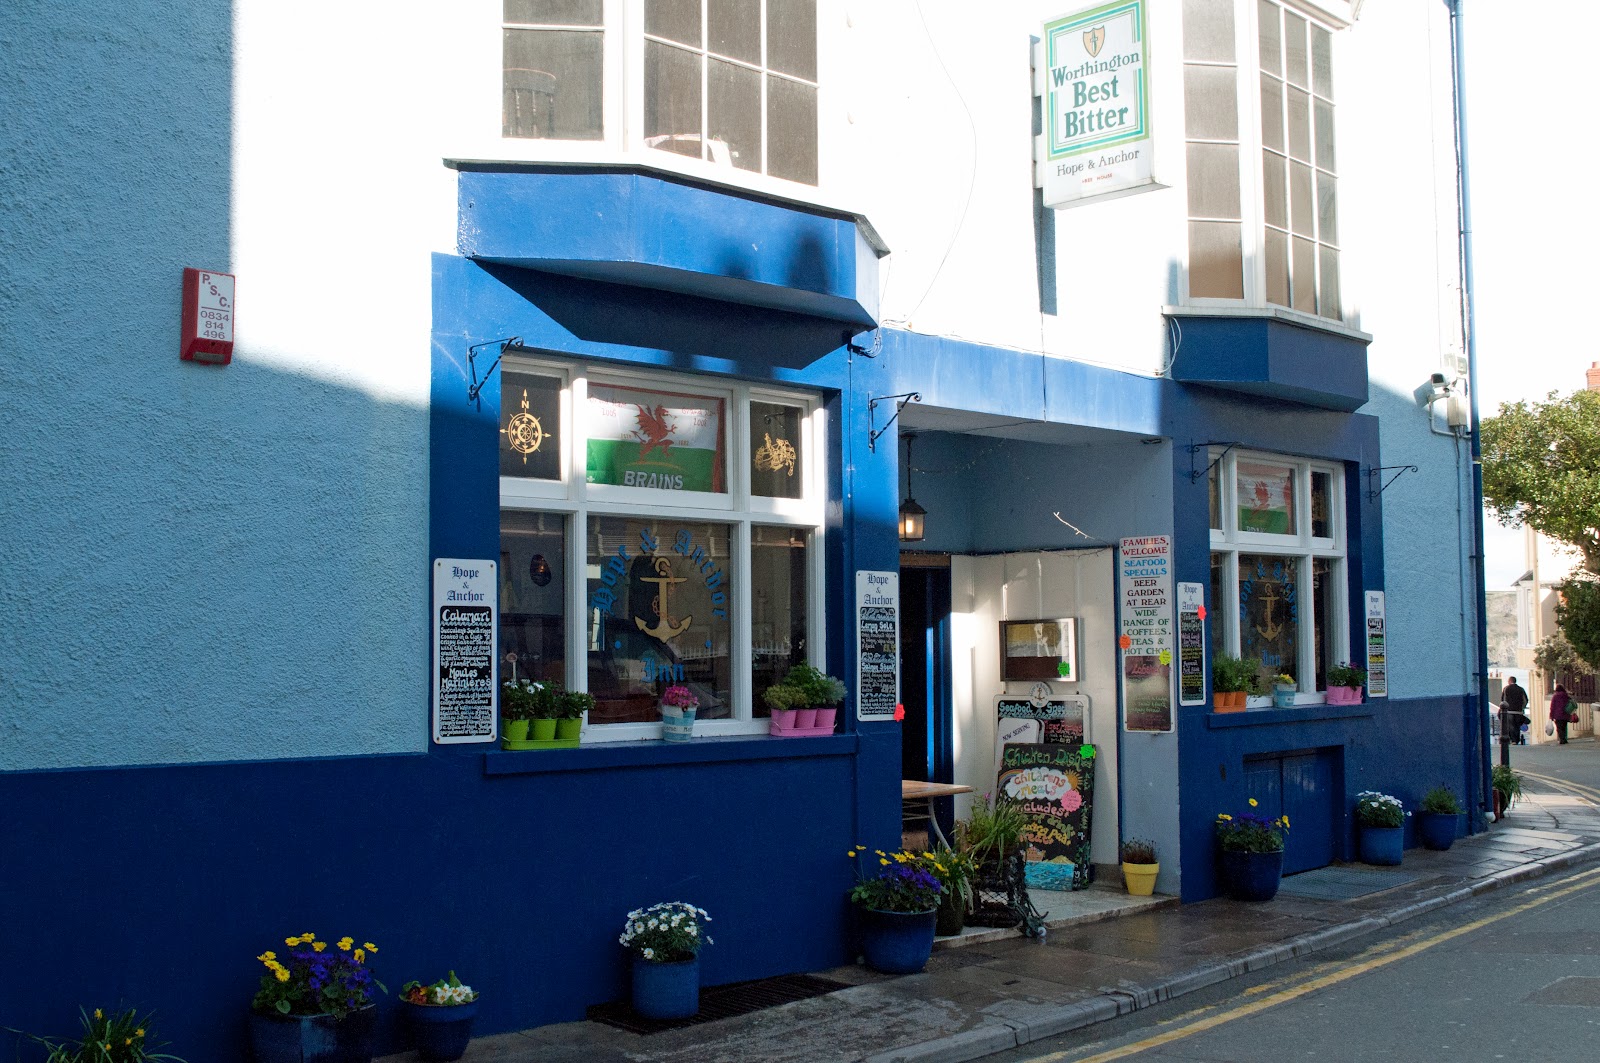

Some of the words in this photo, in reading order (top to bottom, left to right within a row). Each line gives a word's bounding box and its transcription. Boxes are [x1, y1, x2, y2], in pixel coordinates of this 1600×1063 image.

[1052, 52, 1139, 88] Worthington
[1072, 75, 1119, 108] Best
[1064, 106, 1129, 139] Bitter
[1057, 163, 1084, 176] Hope
[1088, 160, 1095, 169] &
[1098, 150, 1139, 168] Anchor
[200, 310, 229, 321] 0834
[205, 321, 224, 330] 814
[203, 329, 225, 339] 496
[624, 470, 684, 490] BRAINS
[1123, 536, 1166, 547] FAMILIES
[1122, 546, 1167, 556] WELCOME
[1124, 558, 1166, 567] SEAFOOD
[452, 566, 480, 579] Hope
[591, 544, 631, 618] Hope
[640, 527, 658, 553] &
[672, 528, 728, 622] Anchor
[1124, 568, 1167, 577] SPECIALS
[462, 581, 469, 589] &
[867, 573, 889, 586] Hope
[447, 589, 485, 602] Anchor
[1127, 589, 1164, 597] GARDEN
[864, 594, 894, 606] Anchor
[1141, 598, 1166, 606] REAR
[442, 609, 490, 623] Calamari
[879, 622, 893, 630] Sole
[1123, 619, 1154, 627] RANGE
[1127, 628, 1167, 636] COFFEES
[449, 668, 477, 679] Moules
[639, 657, 685, 682] Inn
[999, 701, 1032, 713] Seafood
[1012, 722, 1031, 737] SERVING
[1004, 747, 1050, 765] Chicken
[1055, 748, 1091, 768] Dish
[1020, 784, 1058, 796] meals
